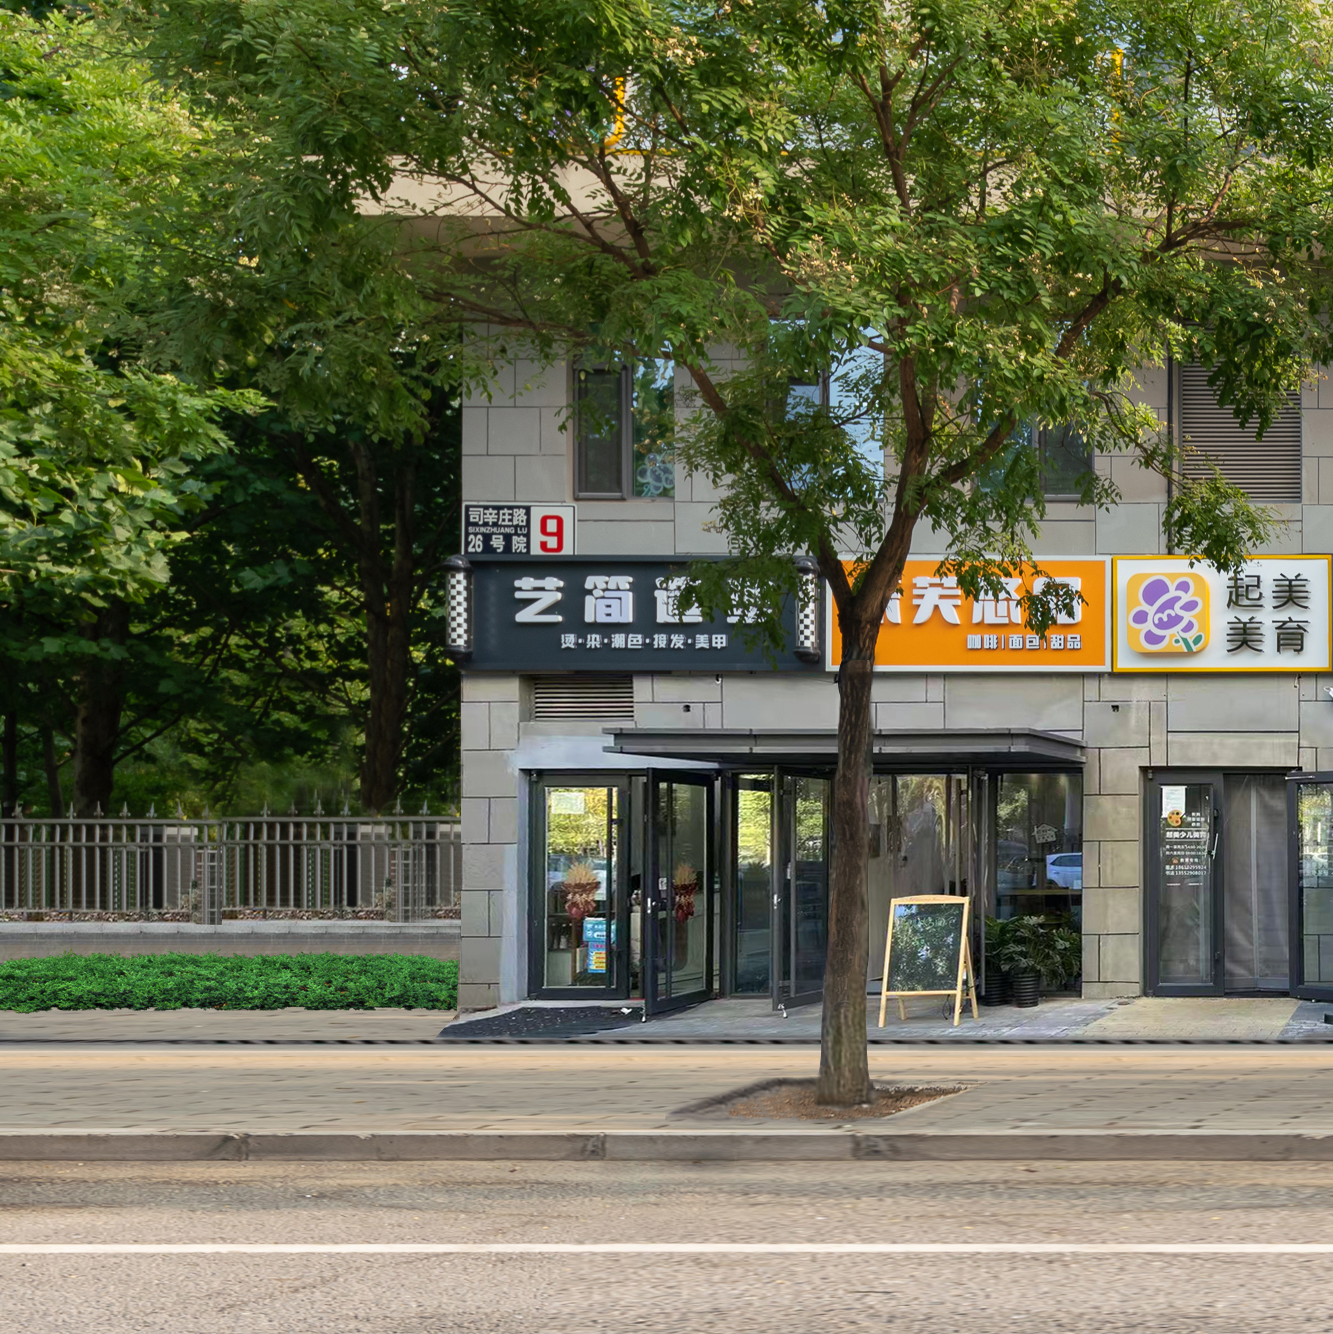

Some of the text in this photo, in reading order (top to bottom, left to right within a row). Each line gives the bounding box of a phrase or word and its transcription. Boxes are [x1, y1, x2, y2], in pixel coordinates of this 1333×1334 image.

[468, 507, 527, 526] 司辛庄路
[539, 514, 564, 554] 9
[1226, 572, 1312, 610] 起美
[1226, 614, 1311, 655] 美育
